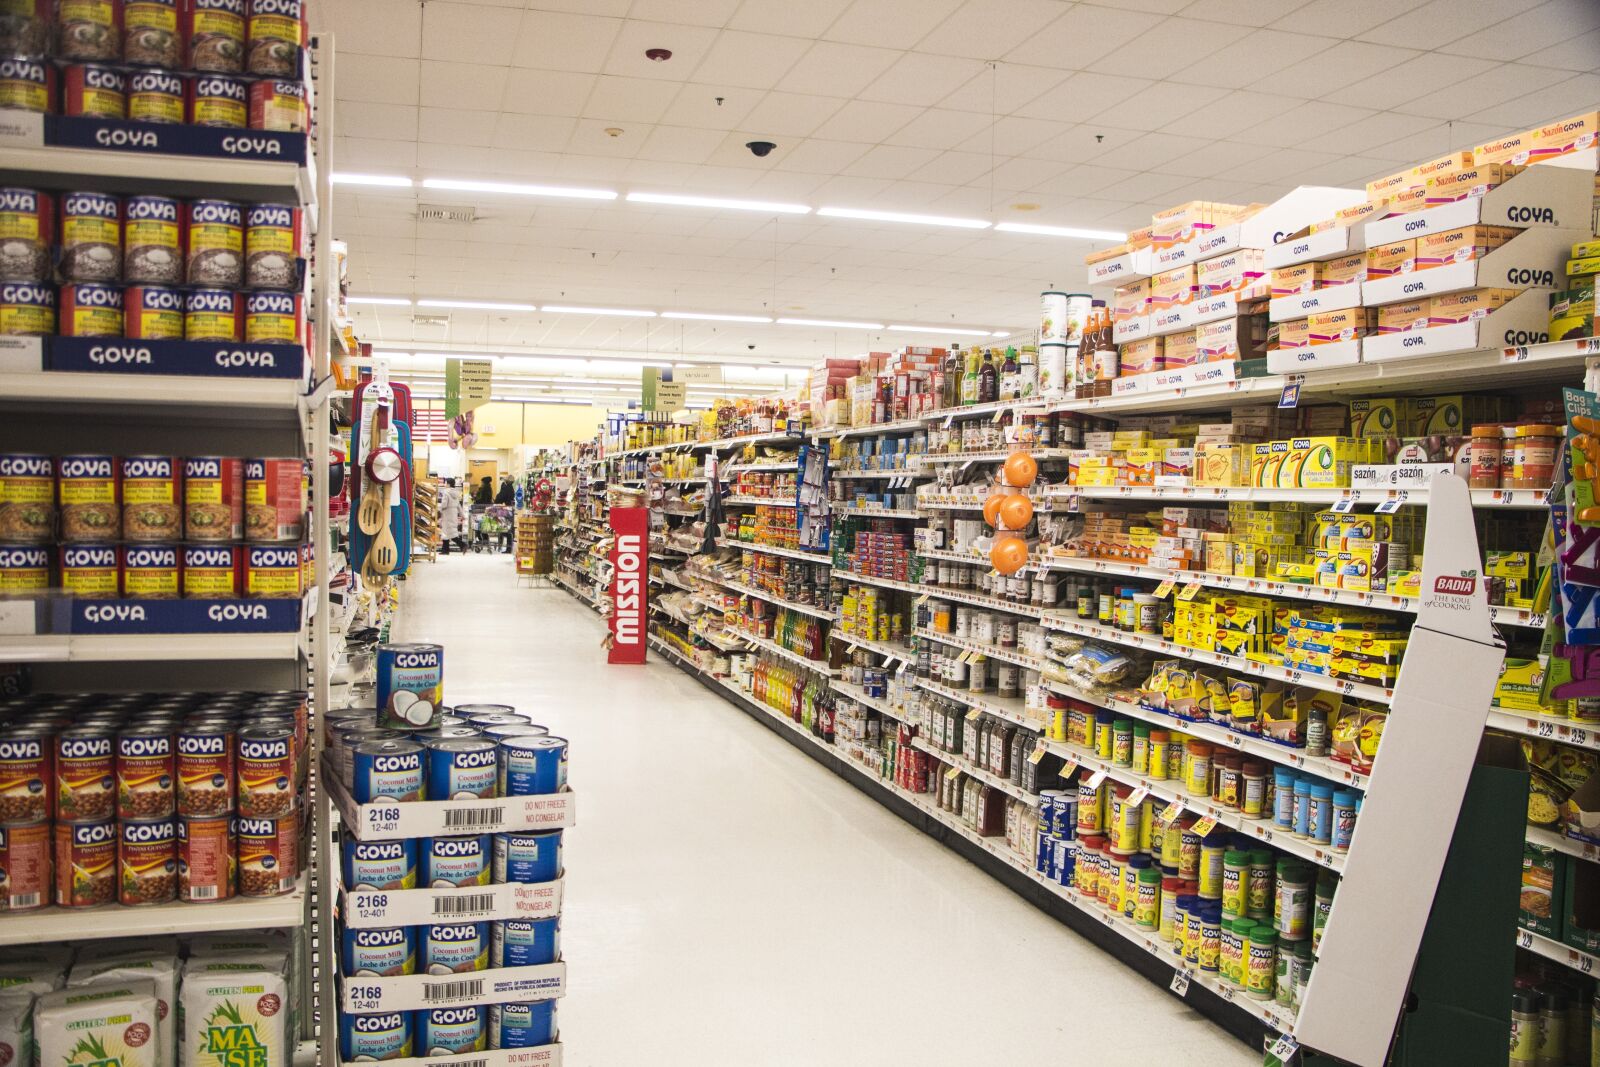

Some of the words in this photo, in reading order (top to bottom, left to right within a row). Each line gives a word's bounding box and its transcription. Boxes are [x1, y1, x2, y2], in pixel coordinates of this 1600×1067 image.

[132, 74, 182, 95] GOYA
[198, 79, 245, 100] GOYA
[1541, 124, 1563, 138] Sazón
[1564, 120, 1584, 132] GOYA
[96, 128, 158, 146] GOYA
[222, 137, 280, 154] GOYA
[1483, 141, 1502, 155] Sazón
[1502, 139, 1520, 149] GOYA
[1437, 160, 1452, 169] GOYA
[1436, 173, 1457, 187] Sazón
[1457, 171, 1477, 182] GOYA
[1398, 189, 1415, 202] Sazón
[66, 198, 117, 218] GOYA
[127, 201, 176, 220] GOYA
[193, 205, 241, 224] GOYA
[1508, 206, 1553, 223] GOYA
[1405, 220, 1426, 231] GOYA
[1211, 236, 1226, 248] GOYA
[1426, 232, 1445, 246] Sazón
[1445, 233, 1463, 242] GOYA
[1171, 250, 1185, 260] GOYA
[1293, 244, 1309, 254] GOYA
[1391, 246, 1406, 254] GOYA
[1108, 264, 1122, 272] GOYA
[1221, 258, 1236, 269] GOYA
[1346, 258, 1361, 268] GOYA
[1507, 268, 1553, 285] GOYA
[1404, 282, 1424, 293] GOYA
[1211, 301, 1226, 310] GOYA
[1302, 299, 1318, 309] GOYA
[1459, 294, 1478, 304] GOYA
[1168, 314, 1181, 323] GOYA
[1316, 311, 1332, 324] Sazón
[1403, 336, 1423, 347] GOYA
[90, 347, 151, 365] GOYA
[216, 350, 274, 368] GOYA
[1298, 352, 1315, 361] GOYA
[1169, 375, 1182, 383] GOYA
[1207, 369, 1222, 379] GOYA
[1352, 401, 1369, 410] GOYA
[1566, 392, 1585, 406] Bag
[1567, 404, 1591, 416] Clips
[1294, 440, 1310, 448] GOYA
[0, 458, 53, 476] GOYA
[61, 460, 111, 477] GOYA
[124, 461, 170, 478] GOYA
[1354, 468, 1376, 479] sazón
[1400, 466, 1423, 477] sazón
[65, 550, 115, 567] GOYA
[127, 550, 176, 567] GOYA
[185, 550, 231, 567] GOYA
[251, 550, 298, 567] GOYA
[616, 535, 640, 644] mission
[1438, 578, 1472, 591] BADIA
[1433, 602, 1471, 611] COOKING
[1451, 596, 1470, 604] SOUL
[84, 605, 145, 623] GOYA
[208, 605, 267, 622] GOYA
[397, 653, 437, 668] GOYA
[61, 738, 111, 758] GOYA
[120, 738, 169, 756] GOYA
[178, 737, 224, 754] GOYA
[240, 739, 287, 758] GOYA
[456, 750, 495, 766] GOYA
[511, 750, 533, 758] GOYA
[376, 754, 419, 771] GOYA
[525, 802, 533, 810] DO
[535, 801, 548, 809] NOT
[549, 800, 567, 808] FREEZE
[370, 808, 400, 822] 2168
[526, 815, 534, 823] NO
[536, 813, 565, 822] CONGELAR
[125, 823, 173, 842] GOYA
[372, 822, 397, 832] 12-401
[434, 841, 480, 857] GOYA
[511, 838, 535, 847] GOYA
[356, 844, 403, 860] GOYA
[1224, 871, 1238, 879] OYA
[534, 888, 554, 896] FREEZE
[357, 895, 388, 908] 2168
[508, 922, 531, 930] GOYA
[357, 930, 403, 946] GOYA
[431, 926, 476, 940] GOYA
[1250, 948, 1272, 957] GOYA
[1248, 958, 1272, 969] Adobo
[207, 987, 241, 996] GLUTEN
[242, 986, 264, 994] FREE
[351, 987, 381, 999] 2168
[353, 1001, 379, 1009] 12-401
[66, 1019, 106, 1031] GLUTEN
[107, 1015, 132, 1026] FREE
[356, 1014, 402, 1031] GOYA
[432, 1008, 476, 1025] GOYA
[211, 1028, 256, 1050] MA
[508, 1054, 518, 1063] DO
[519, 1053, 531, 1063] NOT
[533, 1051, 551, 1061] FREEZE
